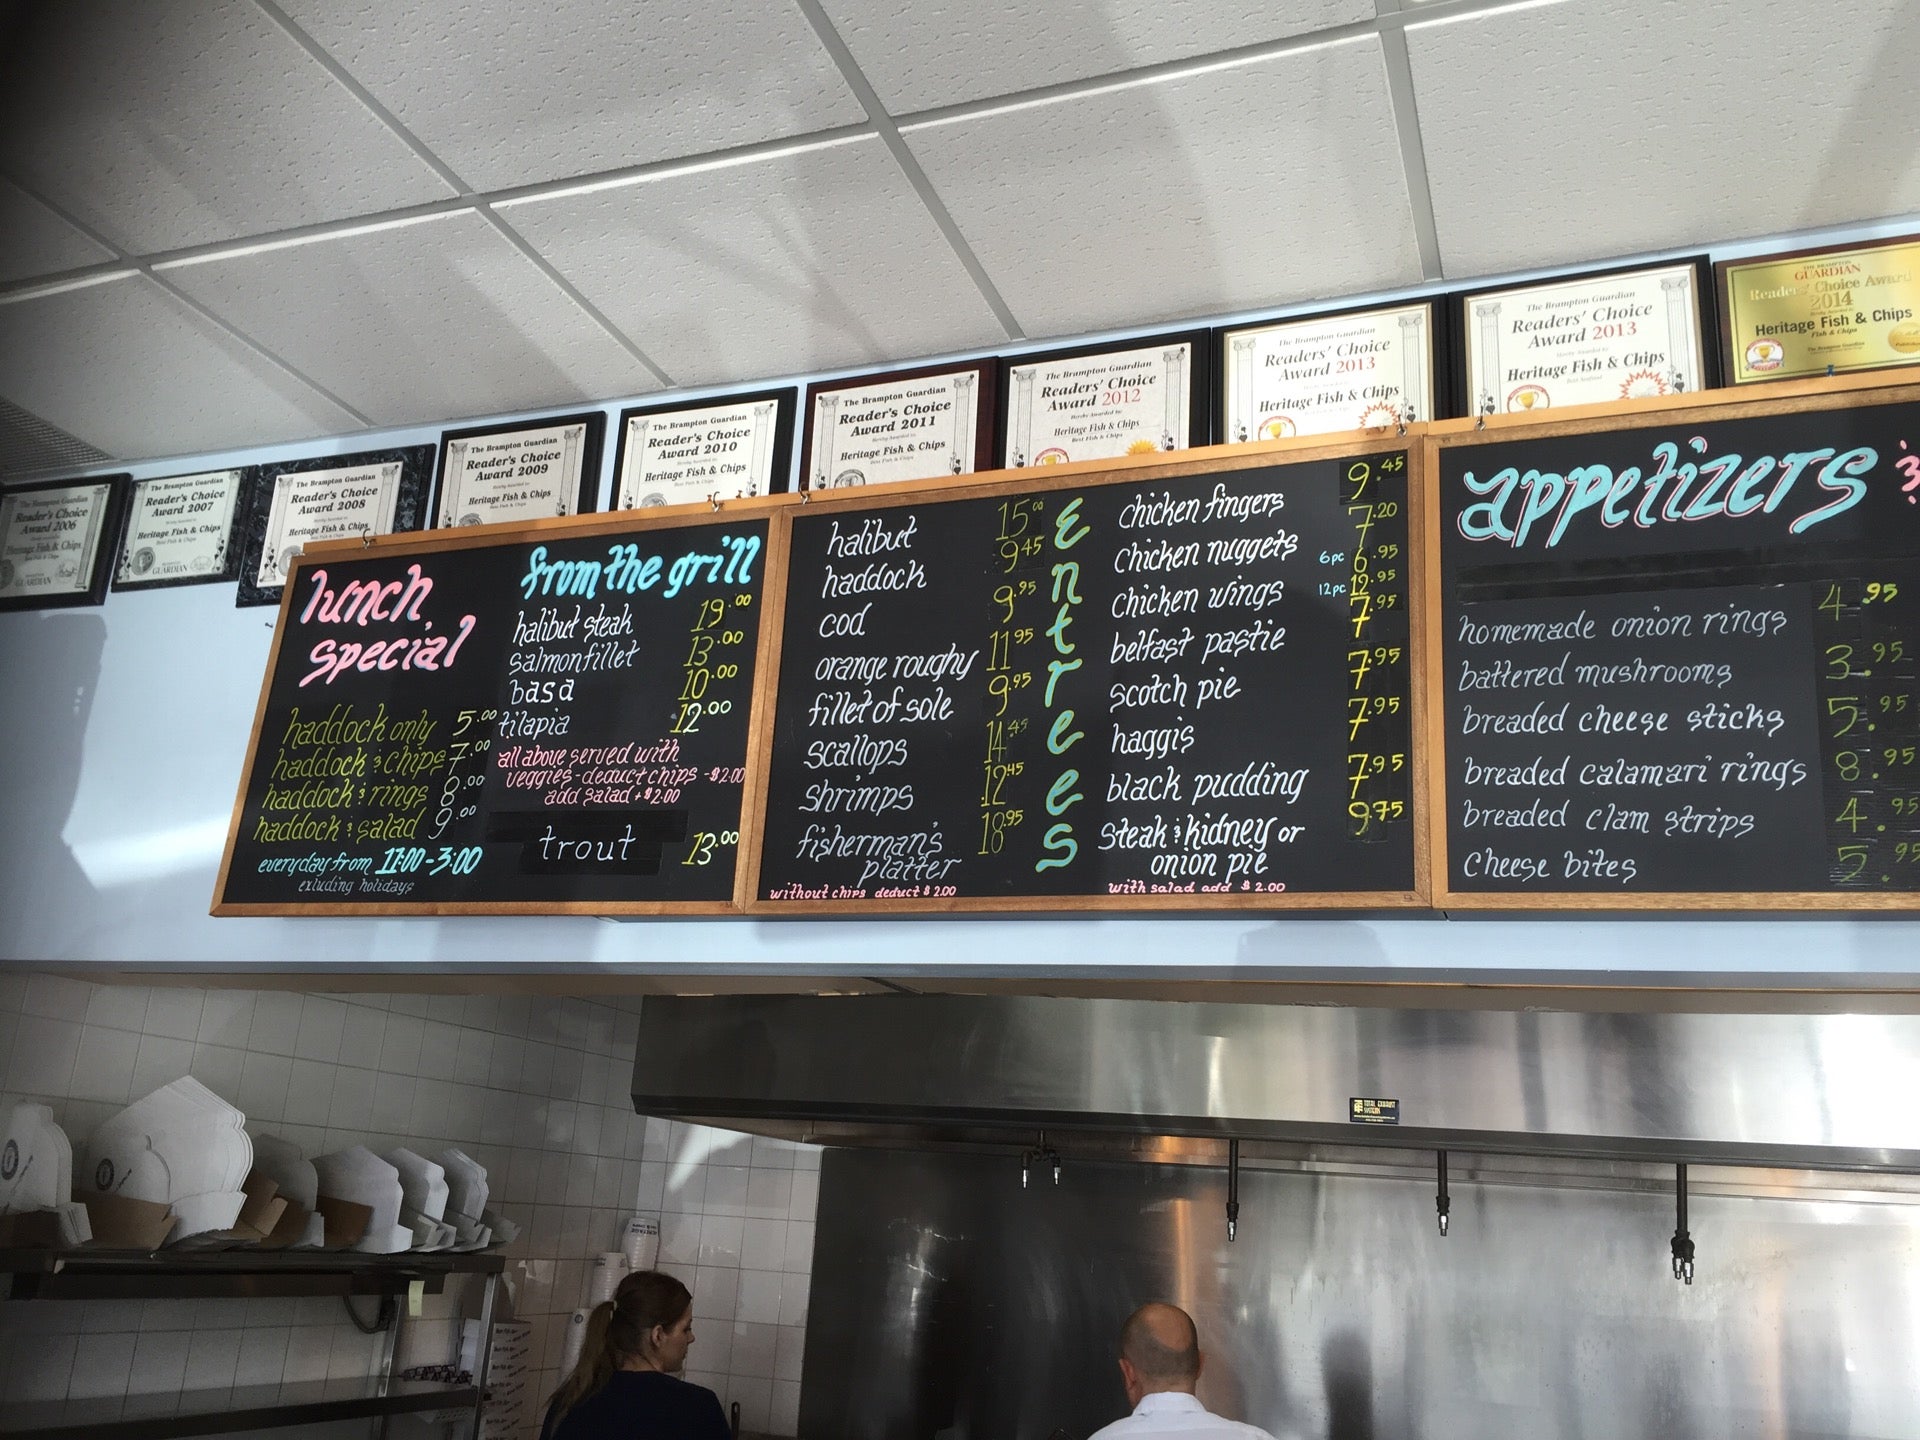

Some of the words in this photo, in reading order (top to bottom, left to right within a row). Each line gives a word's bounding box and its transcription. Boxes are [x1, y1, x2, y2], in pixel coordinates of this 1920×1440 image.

[1794, 264, 1861, 281] GUARDIAN
[1815, 279, 1861, 293] Choice
[1810, 291, 1854, 310] 2014
[1512, 312, 1586, 334] Readers'
[1592, 304, 1653, 322] Choice
[1756, 320, 1815, 337] Heritage
[1821, 316, 1849, 329] Fish
[1855, 313, 1867, 324] &
[1872, 308, 1912, 322] Chips
[1528, 328, 1585, 349] Award
[1592, 321, 1637, 341] 2013
[1265, 347, 1331, 366] Readers'
[1336, 340, 1391, 357] Choice
[1508, 363, 1567, 382] Heritage
[1573, 359, 1602, 373] Fish
[1607, 358, 1618, 369] &
[1623, 352, 1665, 369] Chips
[1279, 363, 1330, 382] Award
[1336, 357, 1375, 374] 2013
[862, 393, 903, 405] Brampton
[906, 387, 946, 397] Guardian
[1041, 379, 1103, 398] Readers'
[1108, 374, 1156, 389] Choice
[1047, 395, 1096, 412] Award
[1102, 388, 1141, 406] 2012
[1259, 395, 1313, 412] Heritage
[1317, 391, 1343, 406] Fish
[1348, 390, 1357, 401] &
[1362, 385, 1400, 401] Chips
[839, 408, 898, 425] Reader's
[904, 400, 951, 416] Choice
[850, 421, 895, 437] Award
[901, 416, 936, 429] 2011
[1054, 426, 1087, 436] Heritage
[1089, 422, 1106, 432] Fish
[1109, 422, 1115, 430] &
[1117, 419, 1139, 431] Chips
[648, 434, 702, 448] Reader's
[707, 428, 751, 441] Choice
[658, 446, 699, 460] Award
[704, 442, 737, 454] 2010
[466, 456, 516, 470] Reader's
[521, 451, 561, 463] Choice
[475, 468, 513, 481] Award
[518, 464, 548, 476] 2009
[645, 470, 683, 481] Heritage
[686, 465, 706, 477] Fish
[709, 466, 716, 474] &
[720, 463, 746, 474] Chips
[145, 494, 187, 507] Reader's
[191, 489, 225, 501] Choice
[291, 491, 337, 504] Reader's
[341, 487, 378, 497] Choice
[298, 503, 334, 515] Award
[338, 499, 366, 510] 2008
[1119, 491, 1200, 529] chicken
[1202, 483, 1284, 523] fingers
[1457, 436, 1879, 548] appetizers
[55, 508, 88, 519] Choice
[152, 506, 184, 517] Award
[188, 502, 214, 513] 2007
[53, 521, 76, 531] 2006
[137, 529, 168, 540] Heritage
[171, 526, 188, 536] Fish
[190, 525, 196, 533] &
[200, 524, 221, 533] Chips
[826, 515, 917, 558] halibut
[1207, 530, 1298, 566] nuggets
[521, 546, 601, 599] from
[604, 543, 663, 594] the
[822, 560, 927, 599] haddock
[1112, 584, 1199, 618] chicken
[1208, 575, 1284, 610] wings
[1319, 551, 1344, 566] 6pc
[300, 563, 433, 626] lunch
[1319, 582, 1346, 596] 12pc
[513, 604, 580, 646] halibut
[584, 603, 633, 643] steak
[819, 603, 873, 637] cod
[1458, 609, 1596, 645] homemade
[1611, 604, 1692, 637] onion
[1702, 603, 1787, 638] rings
[299, 614, 476, 687] special
[1110, 627, 1194, 664] belfast
[1201, 619, 1286, 664] pastie
[815, 655, 887, 686] orange
[892, 643, 979, 682] roughy
[1459, 651, 1566, 691] battered
[1574, 658, 1732, 688] mushrooms
[510, 679, 575, 705] basa
[1110, 674, 1186, 712] scotch
[1197, 667, 1241, 710] pie
[809, 690, 872, 726] fillet
[872, 686, 903, 723] of
[900, 687, 954, 722] sole
[1462, 701, 1570, 736] breaded
[1578, 704, 1669, 736] cheese
[1686, 702, 1784, 737] sticks
[282, 703, 389, 749] haddock
[390, 709, 437, 745] only
[498, 708, 570, 740] tilapia
[1111, 716, 1194, 760] haggis
[271, 747, 368, 781] haddock
[384, 745, 446, 780] chips
[498, 746, 521, 768] all
[522, 745, 565, 767] above
[570, 742, 635, 767] served
[634, 739, 680, 763] with
[804, 734, 908, 775] scallops
[1106, 766, 1182, 802] black
[1192, 761, 1310, 806] pudding
[1464, 755, 1570, 785] breaded
[1579, 755, 1710, 787] calamari
[1721, 752, 1807, 791] rings
[799, 774, 914, 816] shrimps
[253, 812, 340, 842] haddock
[357, 807, 427, 844] salad
[1184, 813, 1278, 852] kidney
[1278, 825, 1305, 843] or
[1463, 798, 1570, 828] breaded
[1585, 803, 1649, 834] clam
[1664, 805, 1754, 838] strips
[539, 824, 636, 860] trout
[330, 851, 373, 874] from
[858, 855, 962, 888] platter
[1151, 847, 1217, 878] onion
[1225, 845, 1268, 883] pie
[1564, 849, 1637, 884] bites
[359, 875, 414, 895] holidays
[770, 882, 829, 900] without
[832, 884, 866, 898] chips
[875, 887, 919, 898] deduct
[1109, 878, 1146, 894] with
[1151, 880, 1195, 894] salad
[1202, 883, 1230, 892] add
